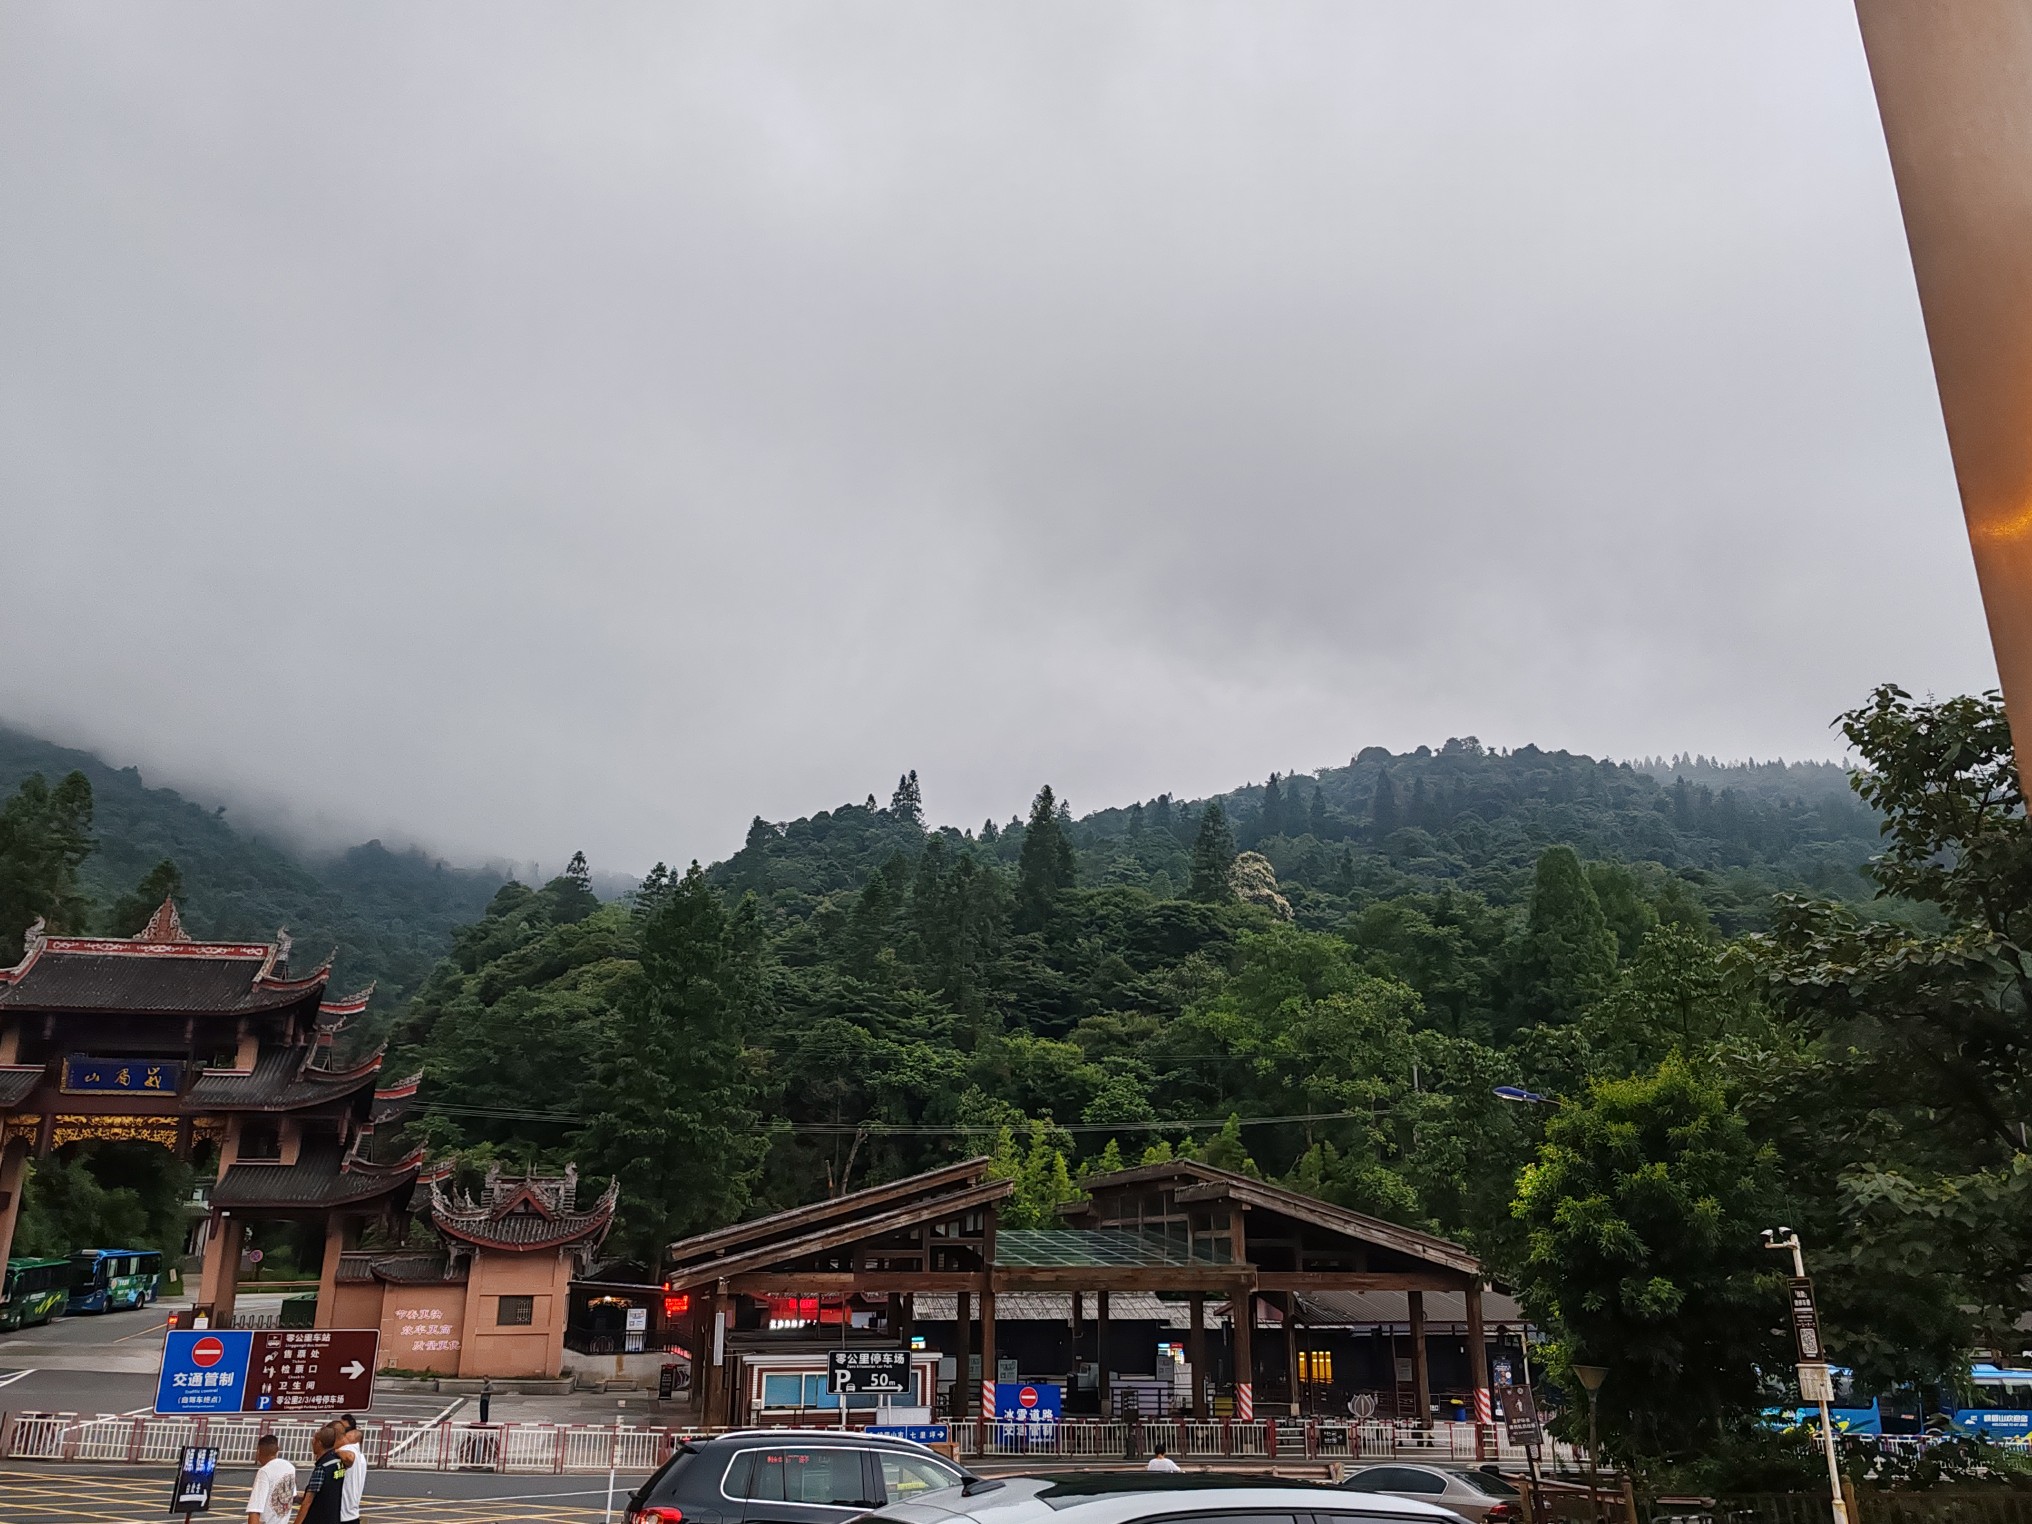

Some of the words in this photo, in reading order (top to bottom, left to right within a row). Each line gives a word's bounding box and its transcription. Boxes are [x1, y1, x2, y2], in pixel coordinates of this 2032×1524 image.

[286, 1333, 331, 1342] 零公里车站
[283, 1349, 320, 1359] 售票处
[835, 1353, 905, 1365] 零公里停车场
[281, 1364, 318, 1374] 检票口
[172, 1371, 234, 1387] 交通管制
[834, 1370, 851, 1392] P
[278, 1381, 315, 1390] 卫生间
[276, 1395, 344, 1405] 零公里2/3/4号停车场
[1004, 1409, 1053, 1421] 冰雪道路
